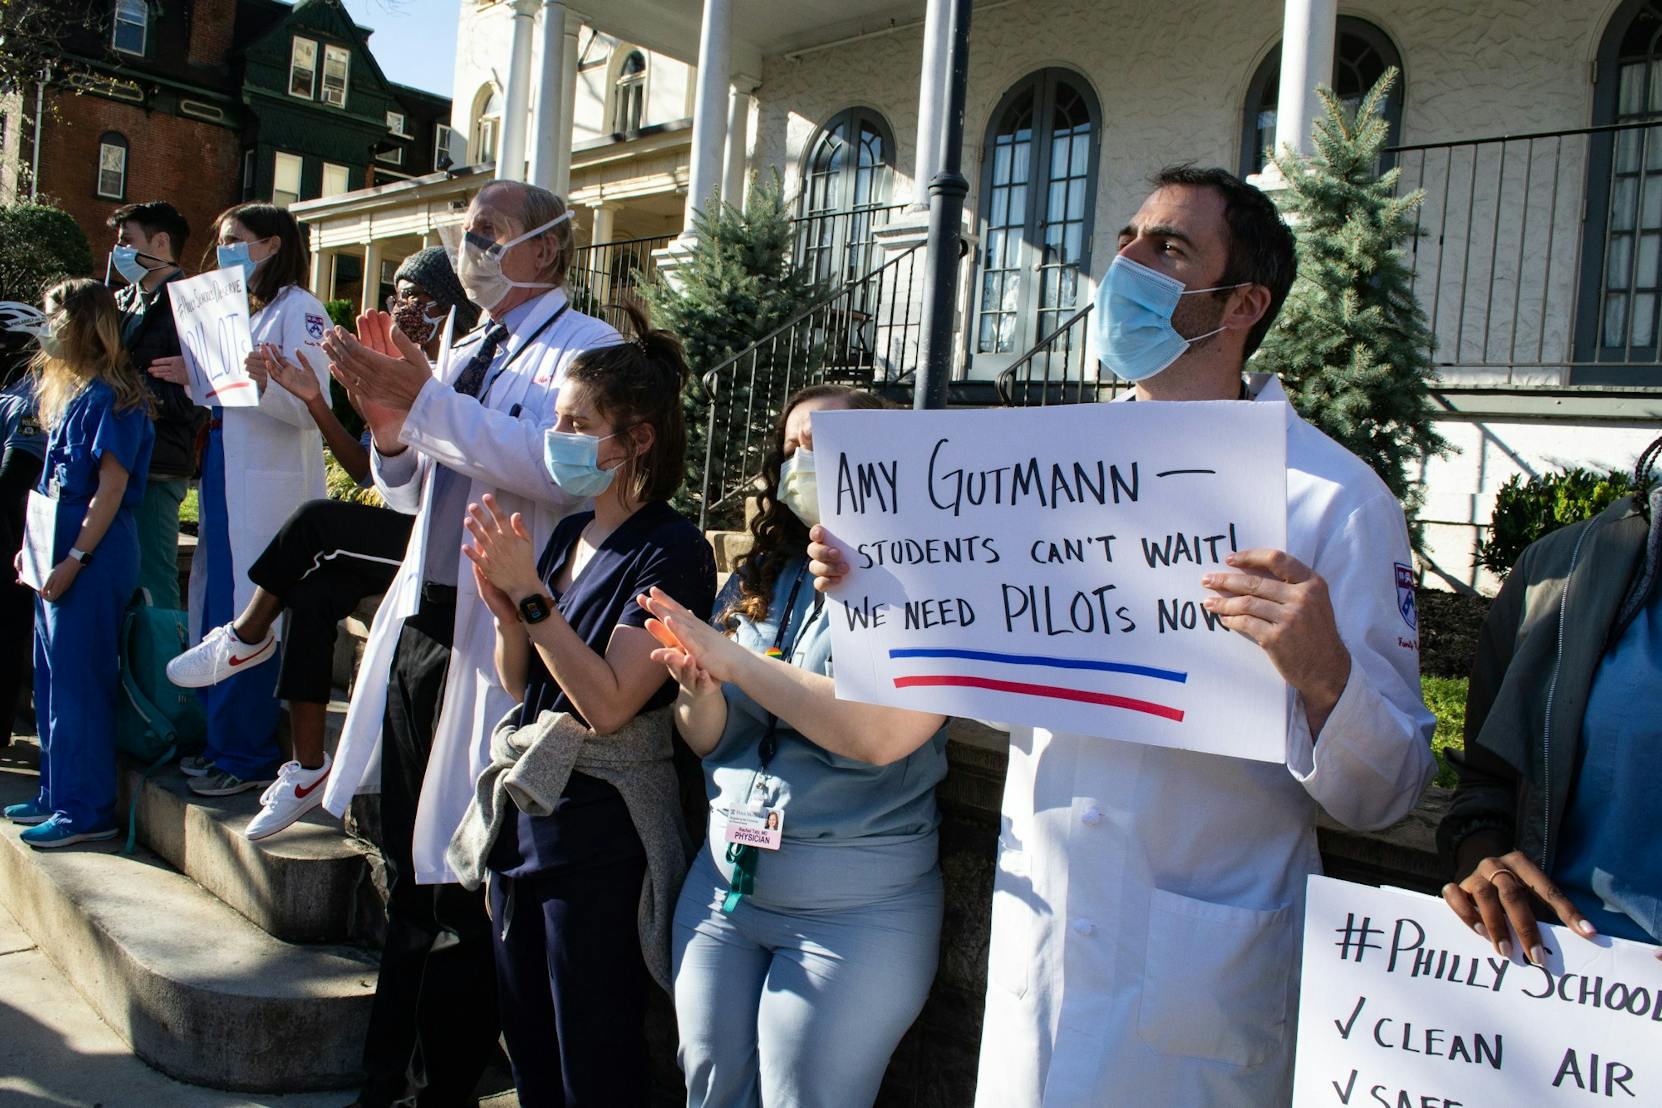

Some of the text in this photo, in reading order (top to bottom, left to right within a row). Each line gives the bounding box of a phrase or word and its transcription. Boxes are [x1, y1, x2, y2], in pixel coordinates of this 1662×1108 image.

[836, 452, 898, 516] AMY
[928, 438, 1139, 516] GUTMANN
[857, 522, 1238, 569] STUDENTS CAN'T WAIT!
[844, 596, 886, 632] WE
[904, 598, 976, 631] NEED
[1158, 598, 1231, 632] NOW
[734, 832, 770, 844] PHYSICIAN
[1373, 1018, 1636, 1098] CLEAN AIR
